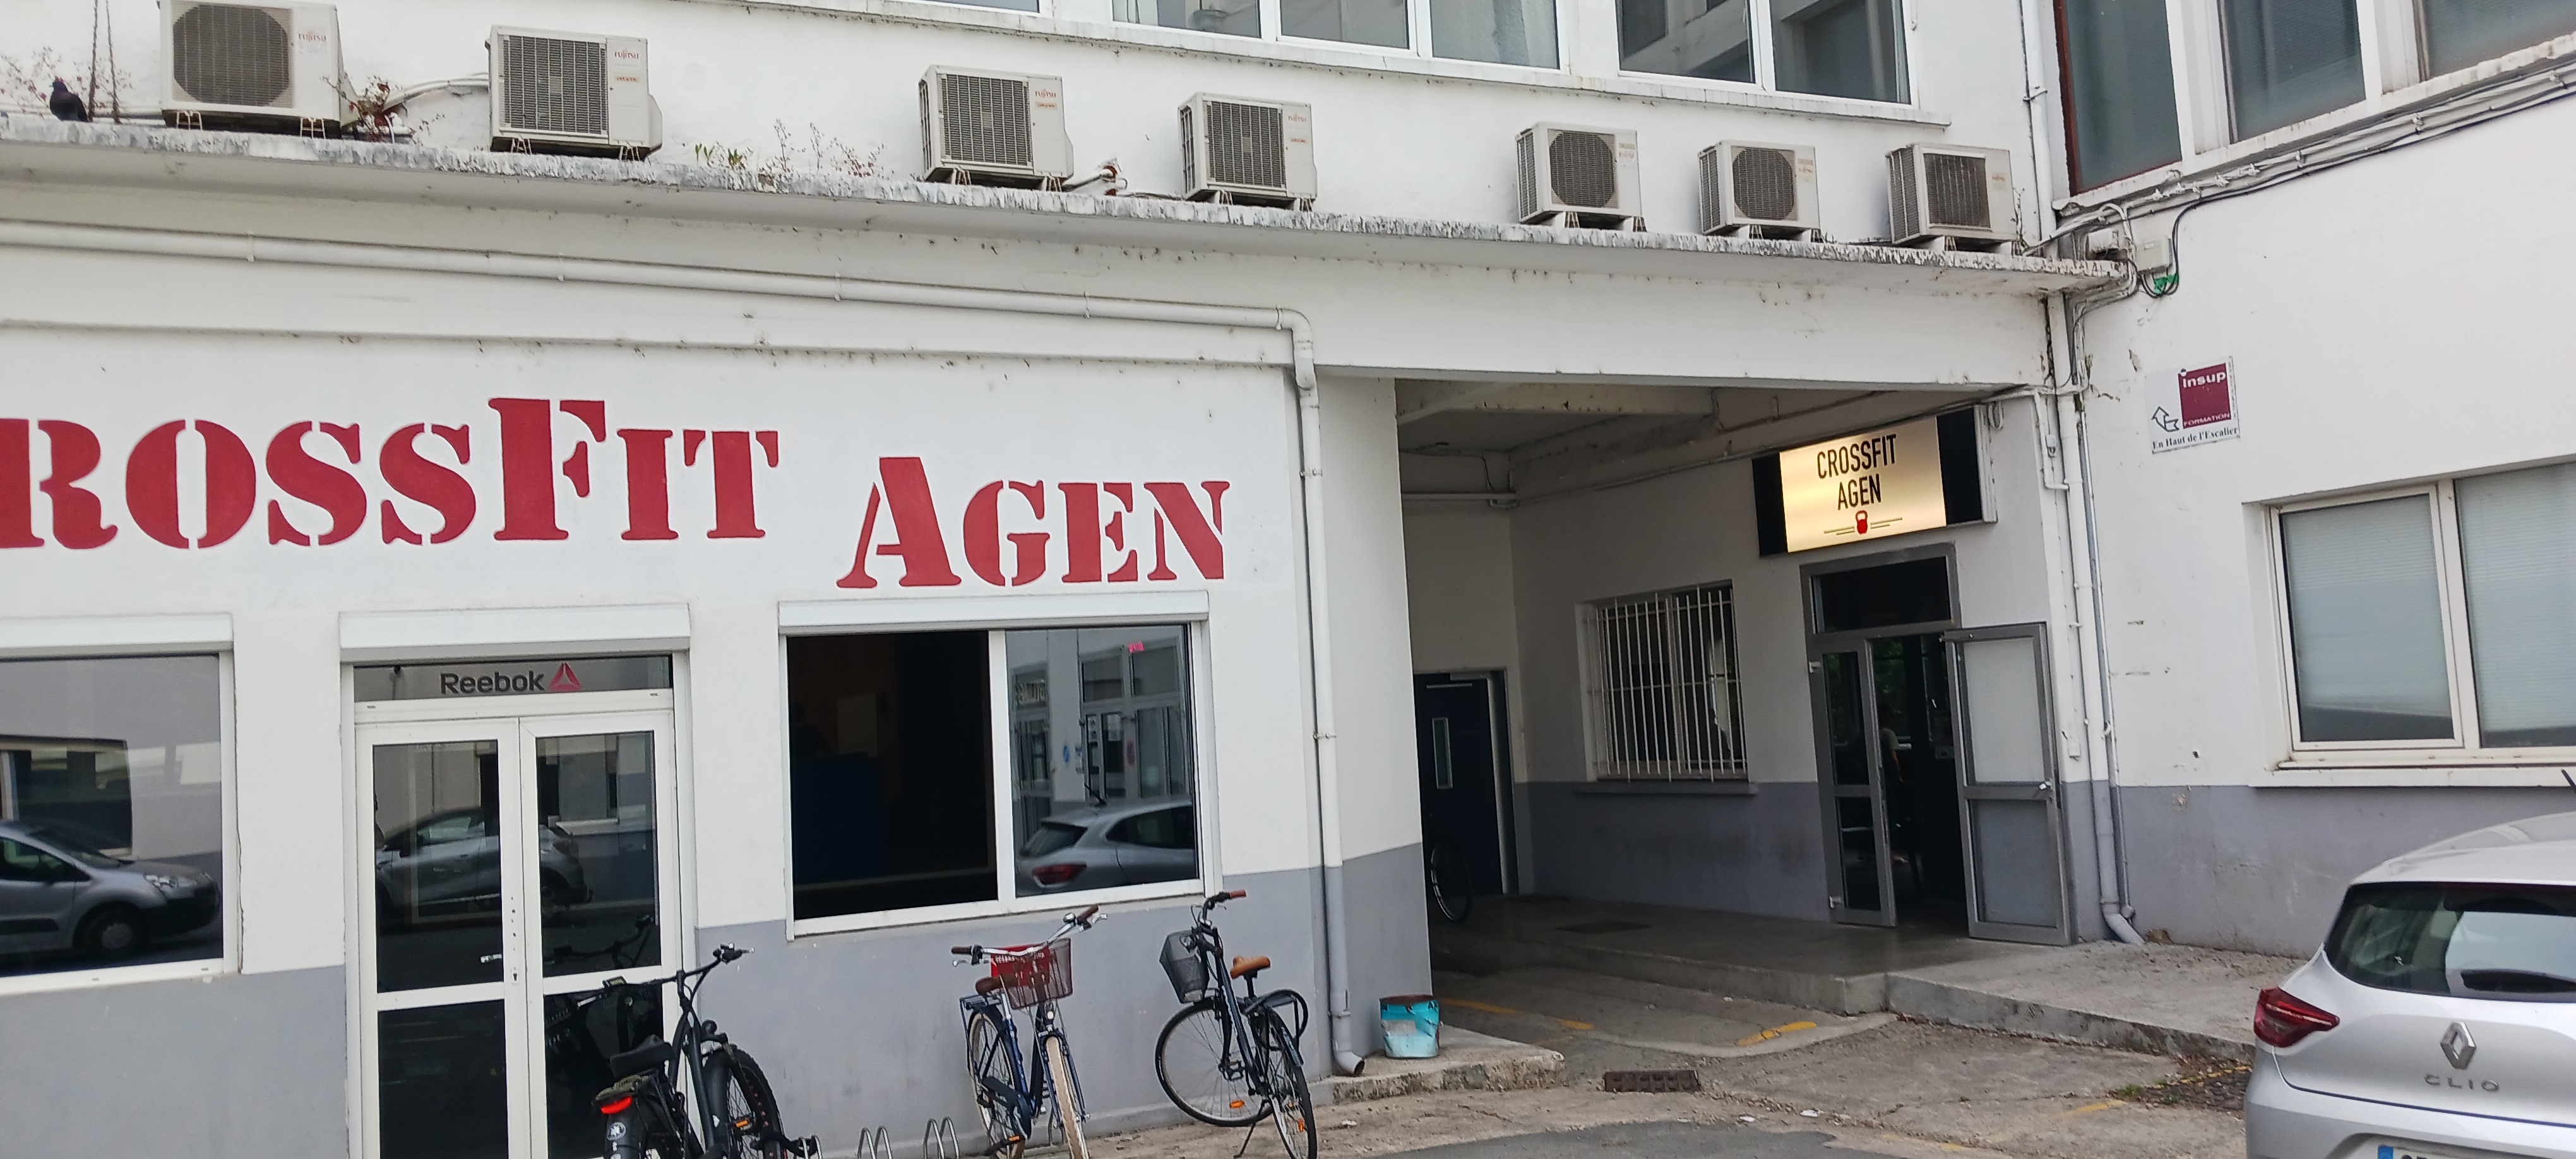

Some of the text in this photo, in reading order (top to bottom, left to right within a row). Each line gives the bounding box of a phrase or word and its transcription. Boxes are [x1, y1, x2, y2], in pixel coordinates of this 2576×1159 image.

[2183, 412, 2230, 427] FORMATION
[2187, 434, 2197, 443] de
[1816, 434, 1897, 479] CROSSFIT
[1837, 473, 1881, 511] AGEN
[440, 670, 545, 694] Reebok
[2424, 1074, 2500, 1092] CLIO
